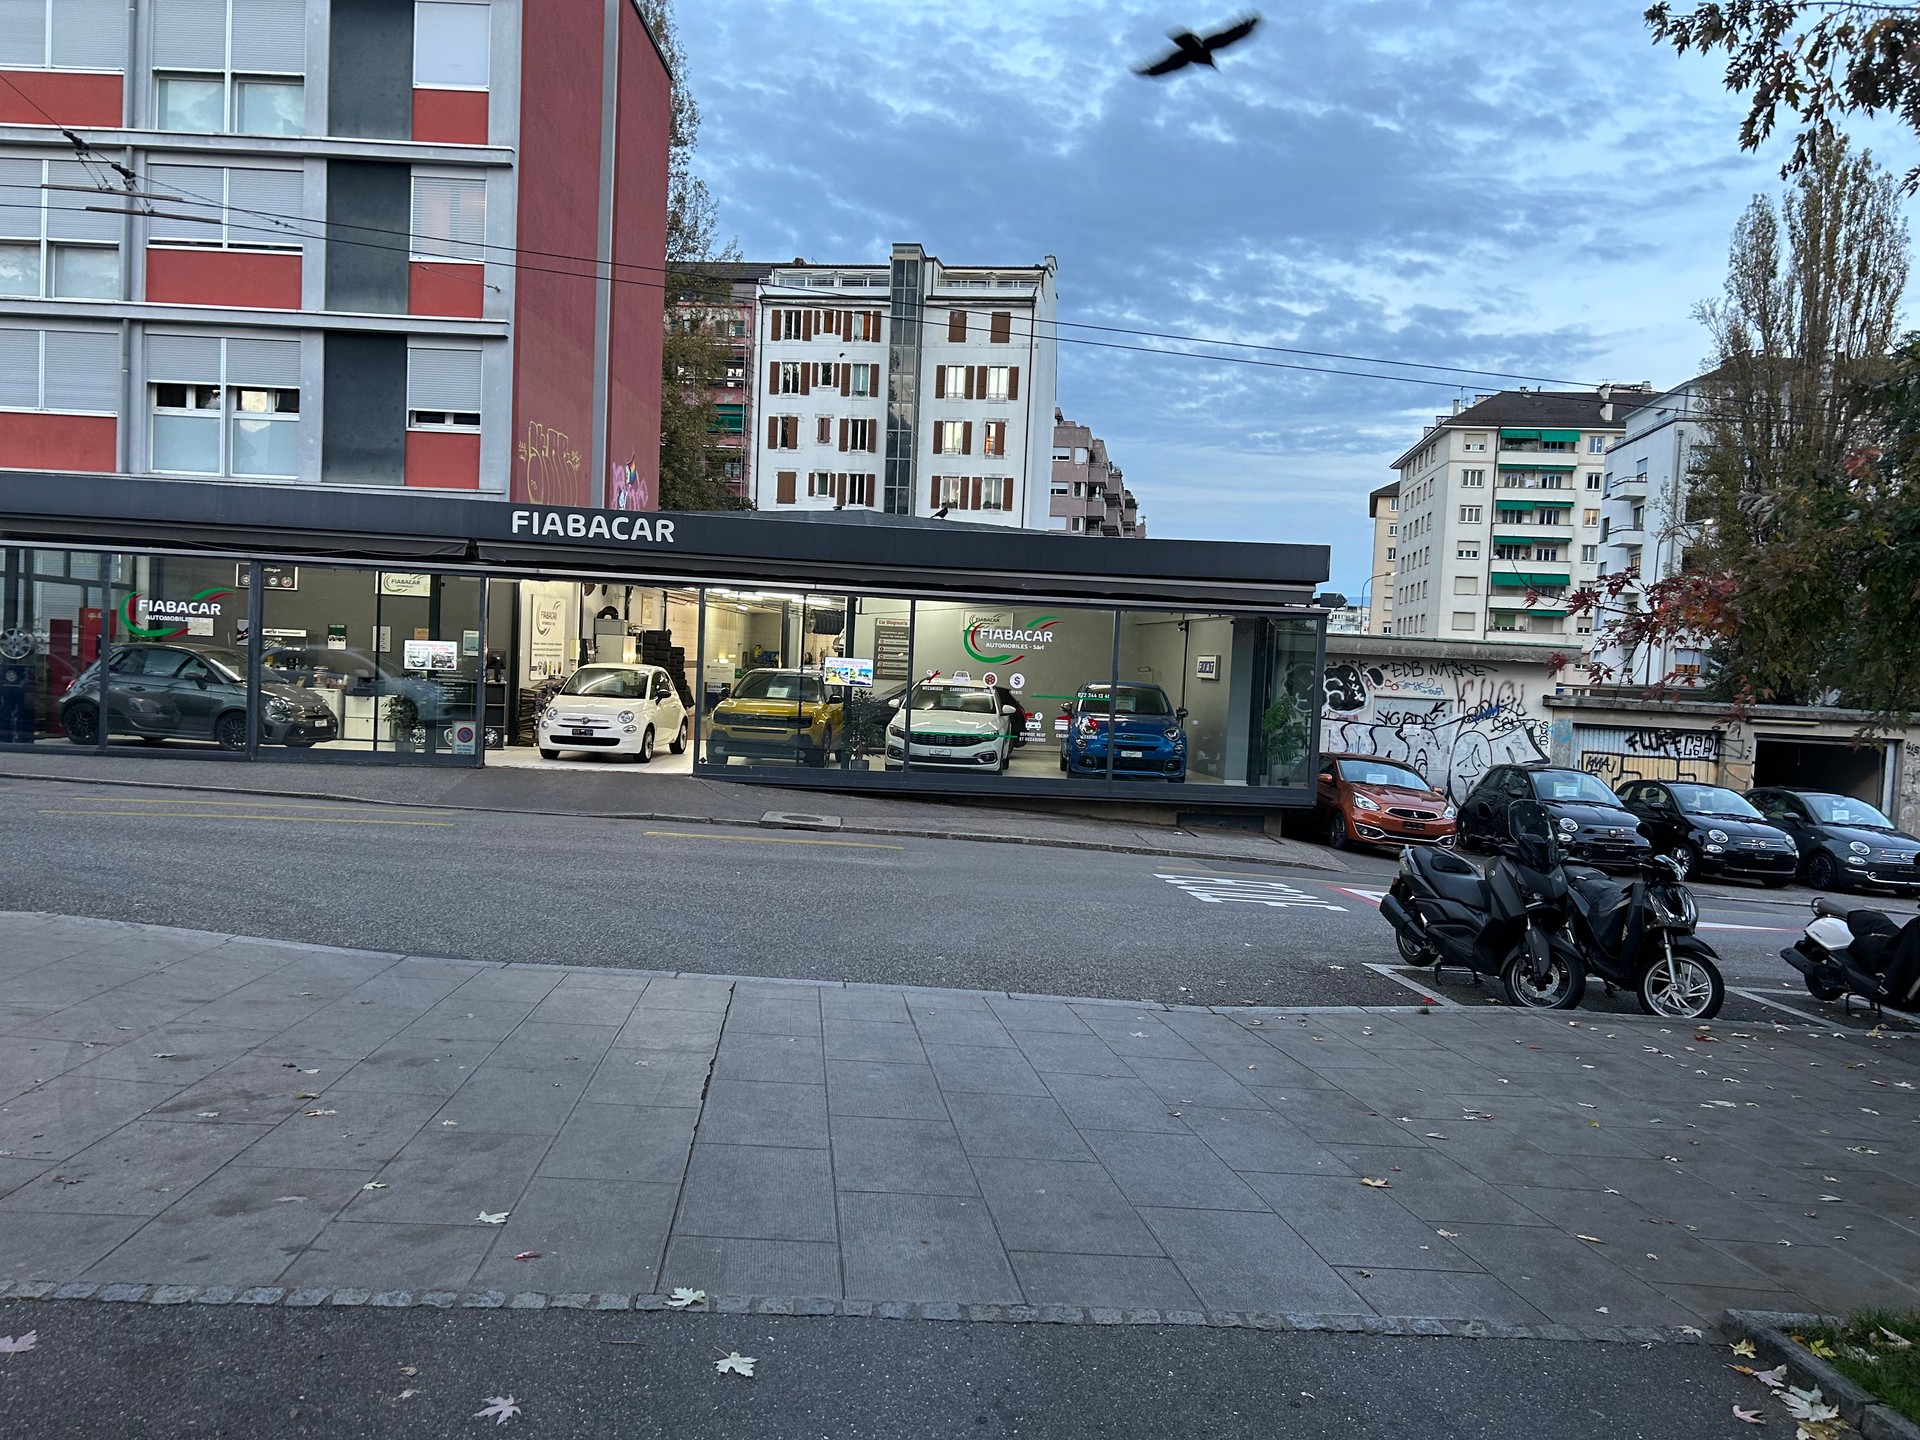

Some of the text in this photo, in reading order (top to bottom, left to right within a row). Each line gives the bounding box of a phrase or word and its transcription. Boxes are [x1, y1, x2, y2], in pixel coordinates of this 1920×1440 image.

[511, 510, 675, 543] FIABACAR
[138, 599, 221, 616] FIABACAR
[980, 628, 1053, 643] FIABACAR
[985, 642, 1028, 650] AUTOMOBILES
[1199, 662, 1215, 672] FIAT
